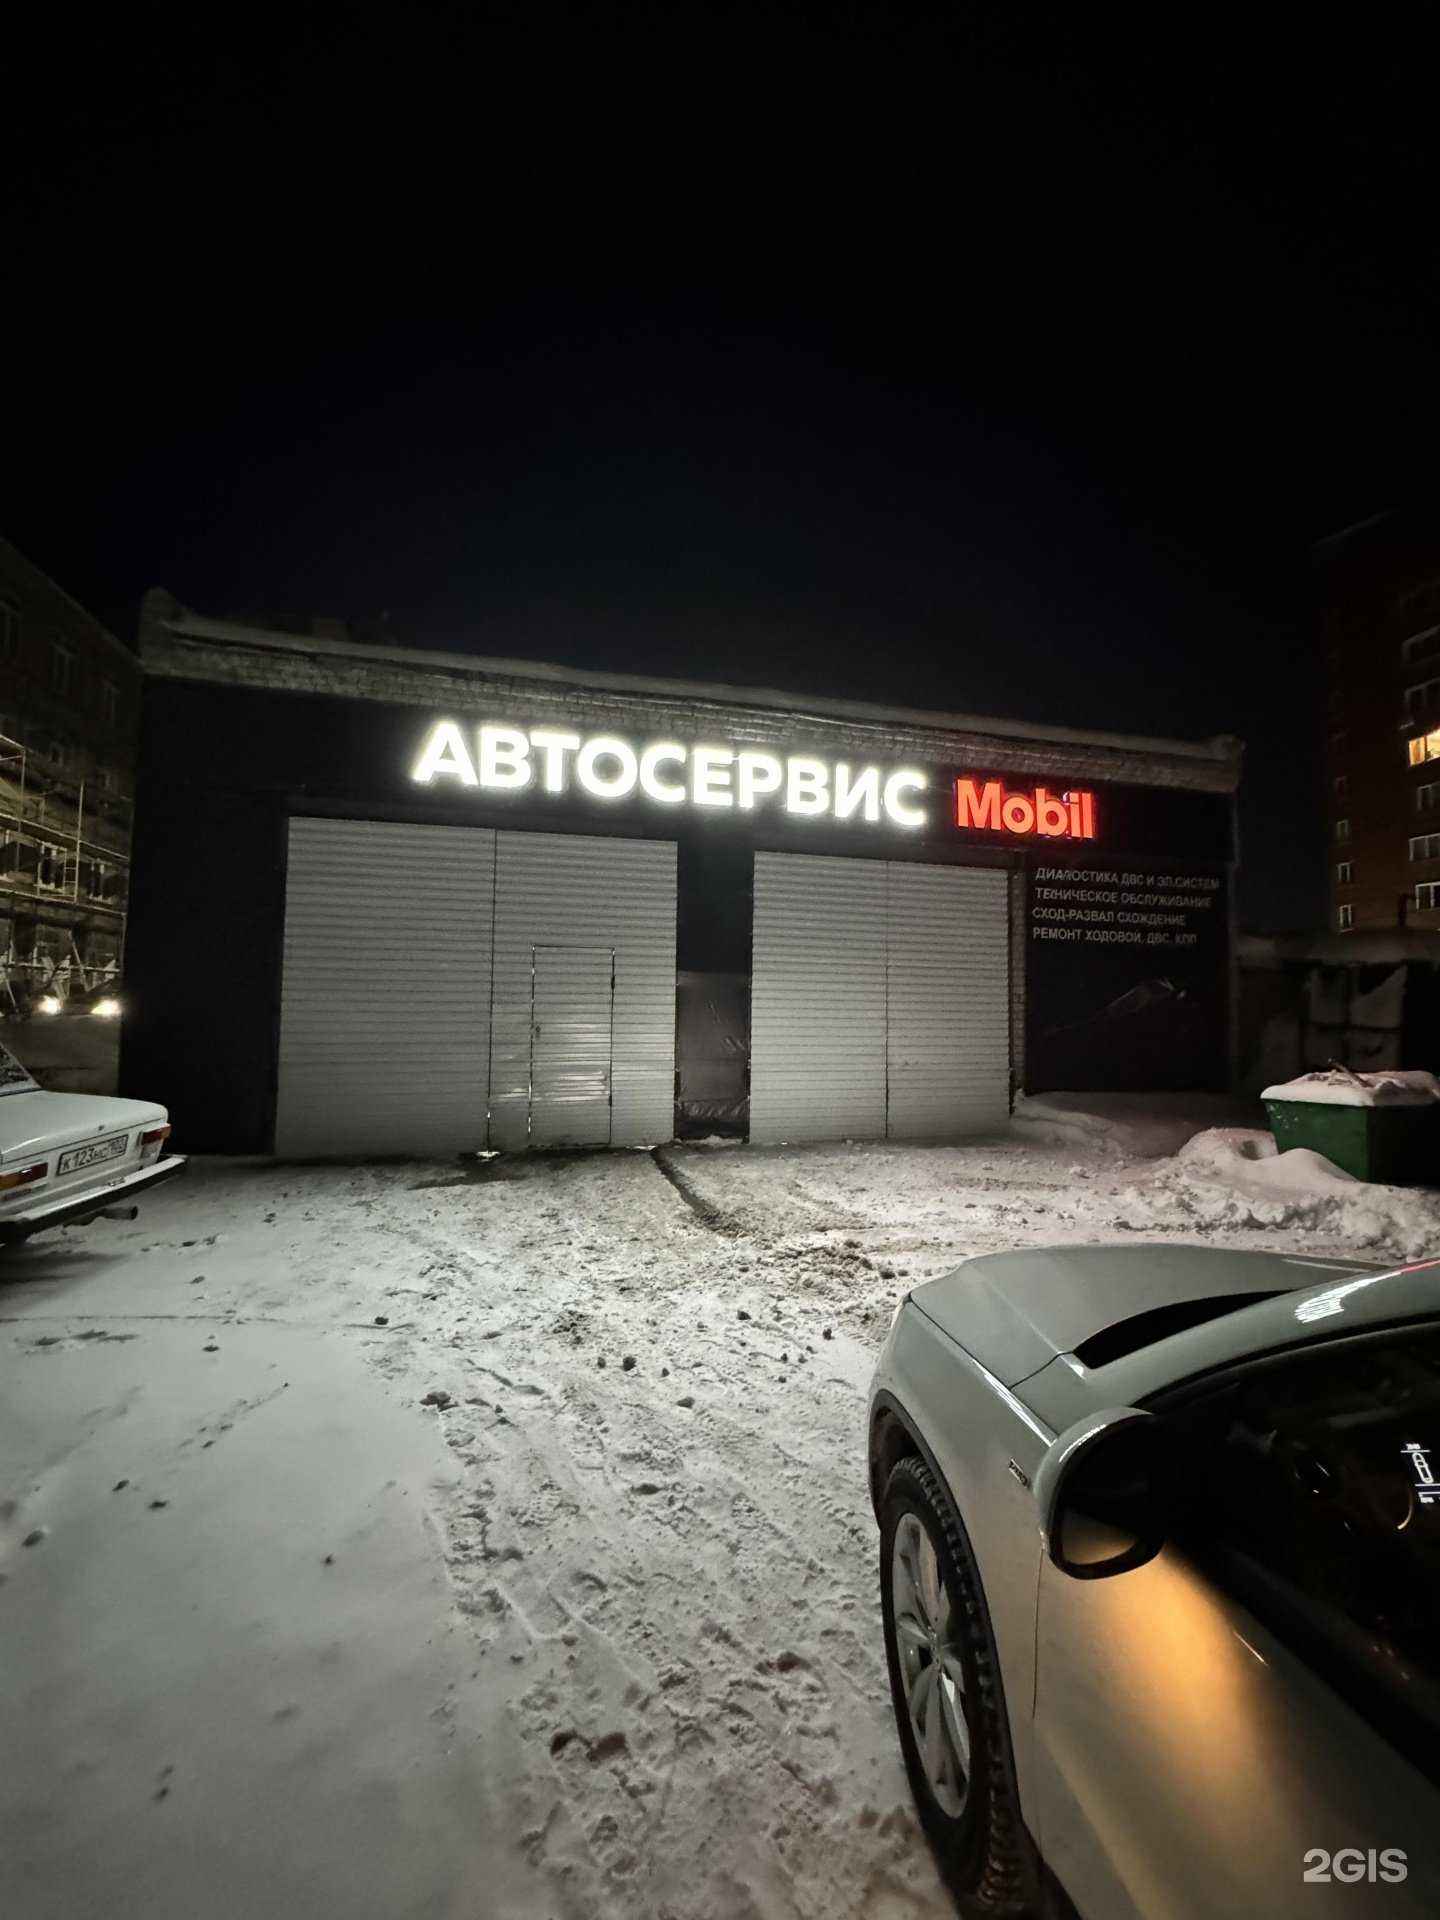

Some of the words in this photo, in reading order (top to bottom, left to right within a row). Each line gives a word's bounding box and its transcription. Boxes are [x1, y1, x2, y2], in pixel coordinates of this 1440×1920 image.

[412, 721, 928, 827] АВТОСЕРВИС
[957, 778, 1094, 840] Mobil
[1121, 872, 1144, 887] ДВС
[1146, 874, 1154, 887] И
[1034, 887, 1117, 903] ТЕХНИЧЕСКОЕ
[1120, 892, 1213, 908] ОБСЛУЖИВАНИЕ
[1116, 912, 1187, 927] СХОЖДЕНИЕ
[1032, 926, 1083, 940] РЕМОНТ
